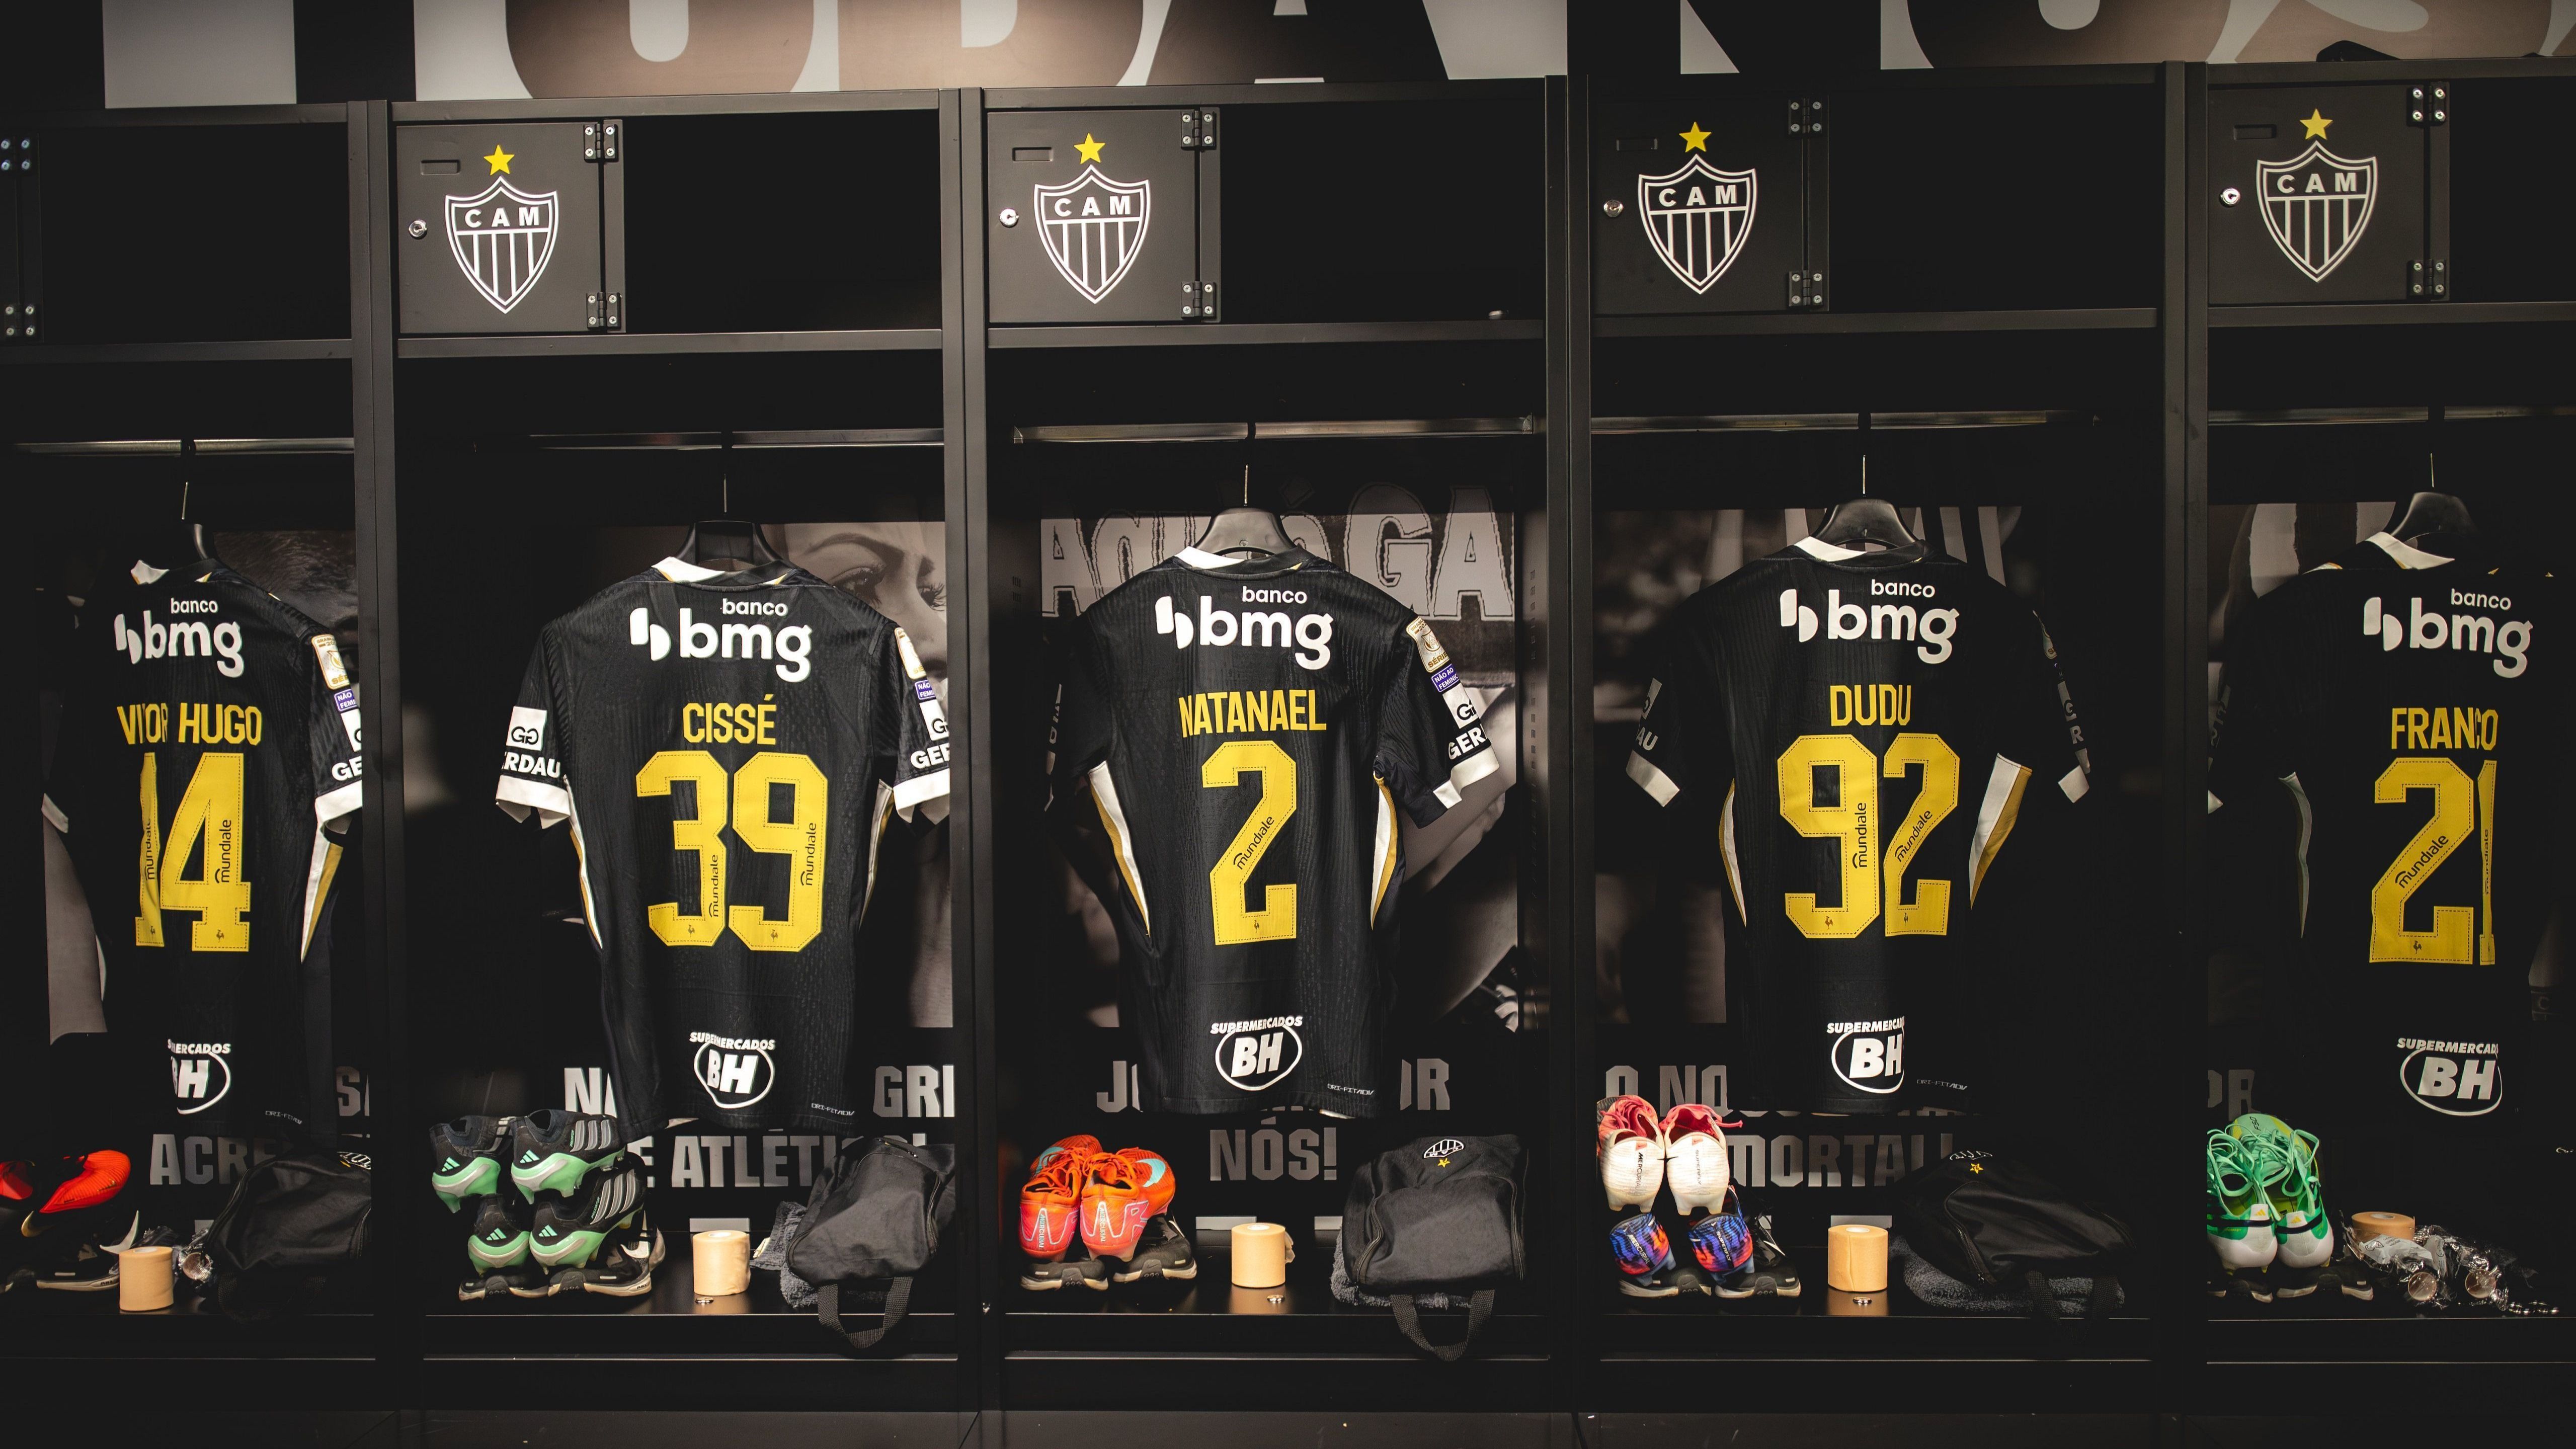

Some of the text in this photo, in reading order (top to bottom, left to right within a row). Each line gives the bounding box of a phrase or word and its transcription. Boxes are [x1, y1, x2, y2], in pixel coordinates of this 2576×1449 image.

[1658, 185, 1737, 208] CAM
[2277, 173, 2357, 194] CAM
[463, 206, 540, 229] CAM
[1054, 195, 1131, 217] CAM
[171, 597, 218, 614] banco
[722, 598, 788, 617] banco
[1242, 586, 1308, 604] banco
[1871, 579, 1936, 598] banco
[2451, 588, 2511, 610] banco
[143, 610, 245, 678] bmg
[679, 607, 813, 683] bmg
[1199, 595, 1334, 670] bmg
[1827, 589, 1960, 664] bmg
[2409, 597, 2533, 678] bmg
[337, 692, 353, 702] NÃO
[1434, 667, 1454, 683] NÃO AO
[1438, 673, 1459, 690] FEMINIC
[116, 702, 263, 746] VIOR HUGO
[340, 699, 356, 709] FEMI
[682, 693, 777, 745] CISSÉ
[1178, 689, 1327, 738] NATANAEL
[1830, 684, 1911, 727] DUDU
[502, 751, 561, 778] RDAU
[1448, 727, 1487, 760] GER
[332, 755, 363, 781] GE
[135, 752, 251, 952] 14
[215, 819, 232, 884] mundiale
[635, 750, 828, 952] 39
[800, 822, 817, 887] mundiale
[1201, 740, 1297, 946] 2
[1233, 816, 1275, 870] mundiale
[1777, 733, 1960, 939] 92
[1853, 802, 1868, 869] mundiale
[1895, 810, 1933, 863] mundiale
[2369, 757, 2497, 965] 21
[2395, 835, 2449, 889] mundiale
[689, 1031, 776, 1051] SUPERMERCADOS
[1210, 1015, 1304, 1034] SUPERMERCADOS
[707, 1049, 759, 1094] BH
[1230, 1032, 1284, 1078] BH
[1848, 1033, 1903, 1079] BH
[2417, 1057, 2496, 1100] BH
[1210, 1115, 1337, 1181] NÓS!
[1716, 1231, 1732, 1261] SUPERFLY
